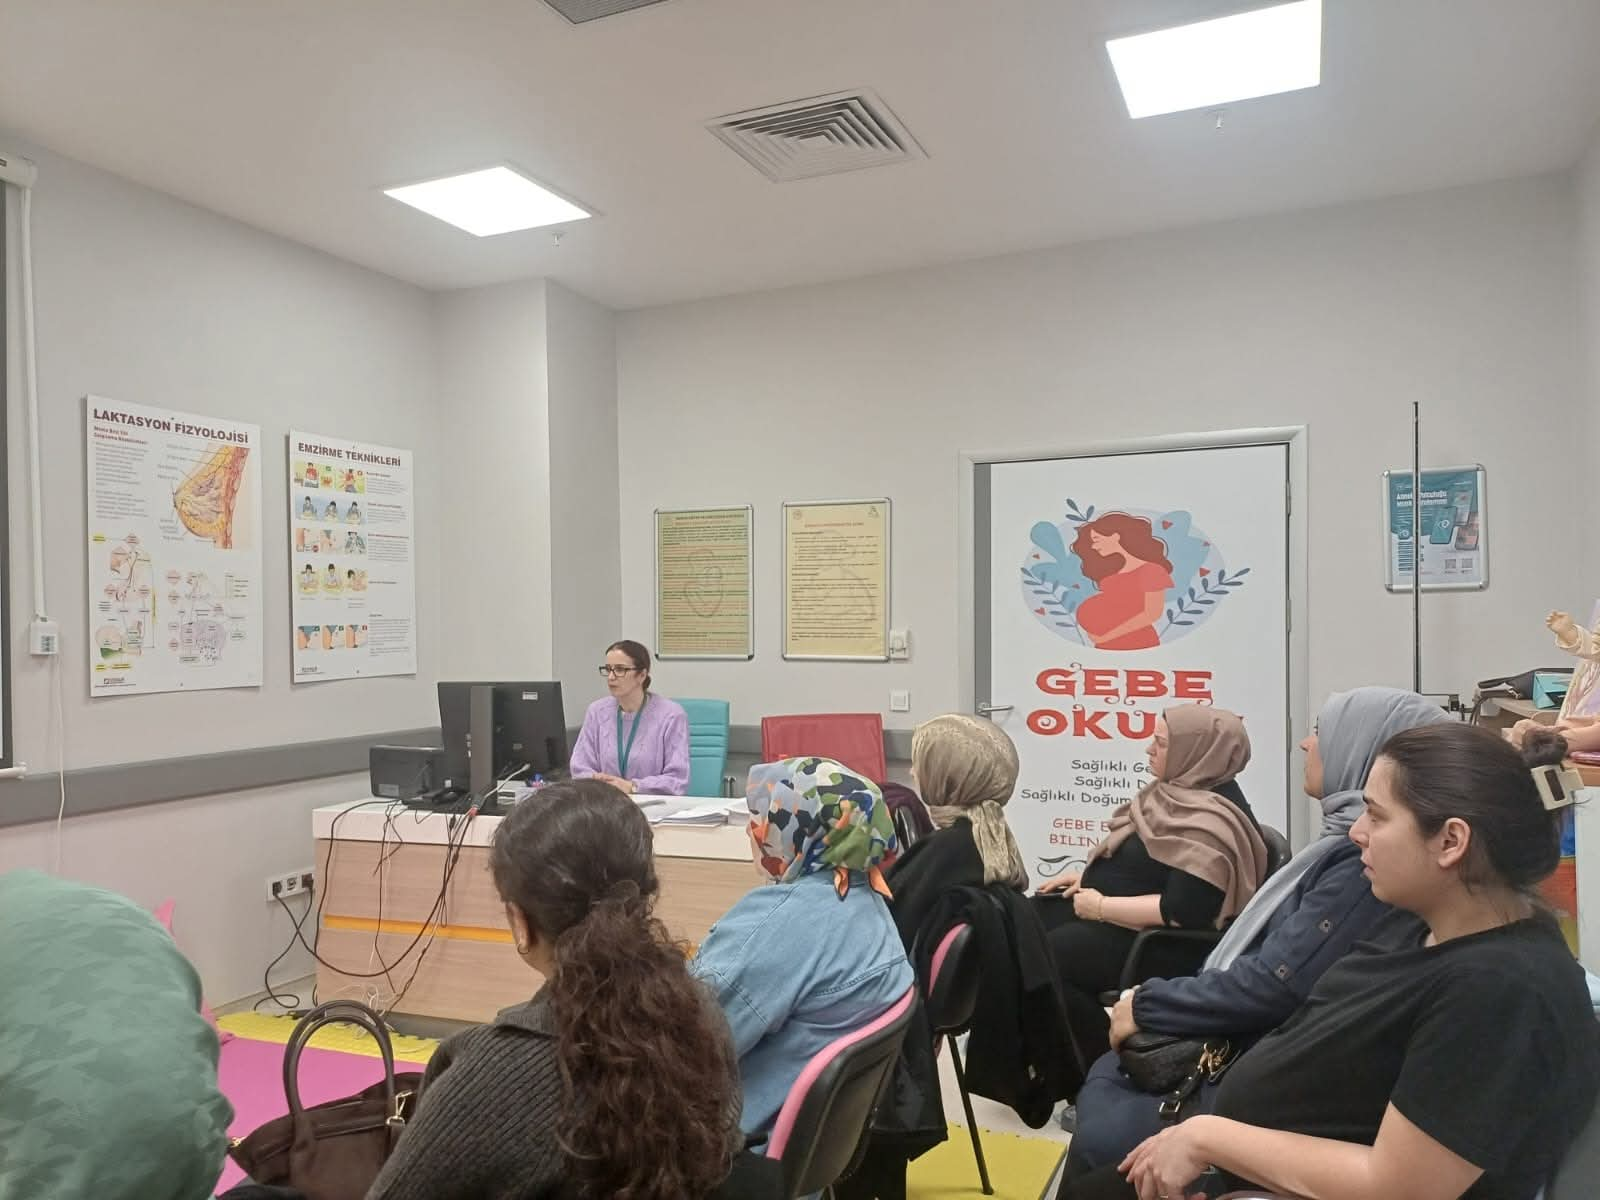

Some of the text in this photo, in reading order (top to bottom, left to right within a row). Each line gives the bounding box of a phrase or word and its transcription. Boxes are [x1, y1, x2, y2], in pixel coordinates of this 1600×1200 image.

[93, 408, 249, 443] LAKTASYON FİZYOLOJİSİ
[298, 442, 401, 467] EMZİRME TEKNİKLERİ
[1036, 664, 1213, 705] GEBE
[1026, 705, 1157, 740] OKU
[1071, 760, 1152, 774] Sağlıklı Ge
[1074, 776, 1131, 790] Sağlıklı
[1021, 788, 1132, 807] Sağlıklı Doğum
[1053, 818, 1095, 831] GEBE
[1049, 834, 1101, 848] BILIN
